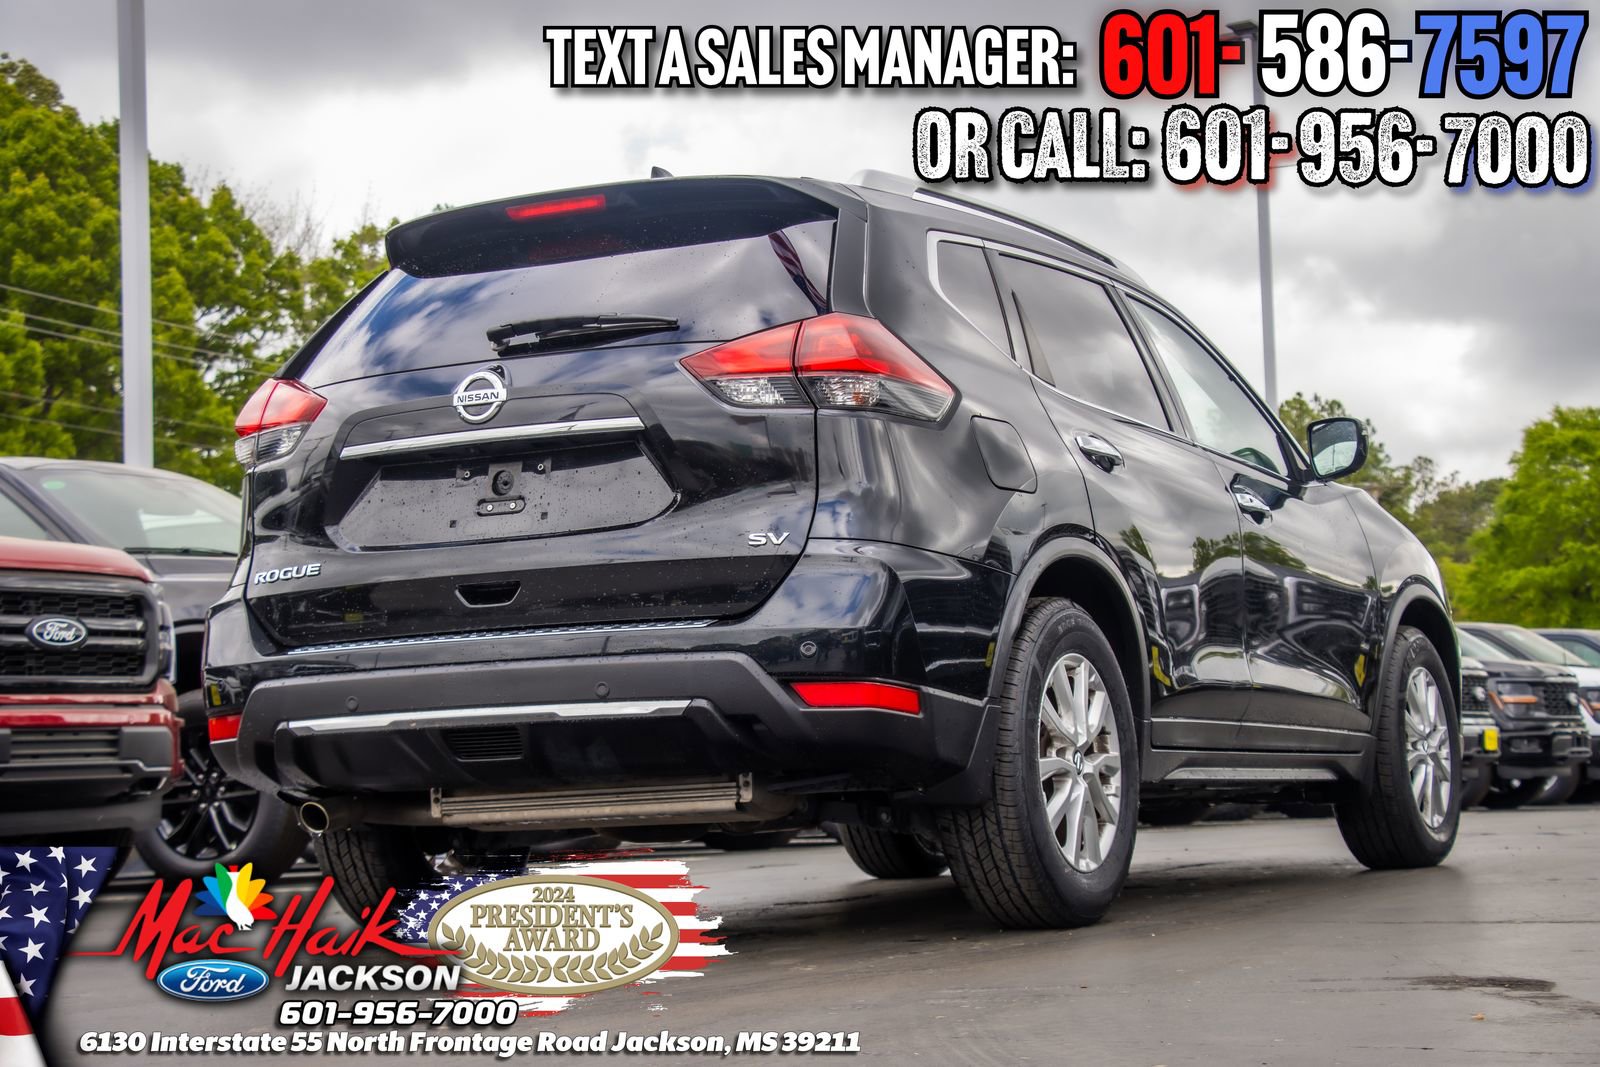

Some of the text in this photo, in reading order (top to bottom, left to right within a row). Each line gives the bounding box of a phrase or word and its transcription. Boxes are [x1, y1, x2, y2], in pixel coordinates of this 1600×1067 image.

[457, 391, 499, 404] NISSAN
[748, 532, 790, 547] SV
[254, 563, 322, 585] ROGUE
[43, 621, 77, 641] Ford
